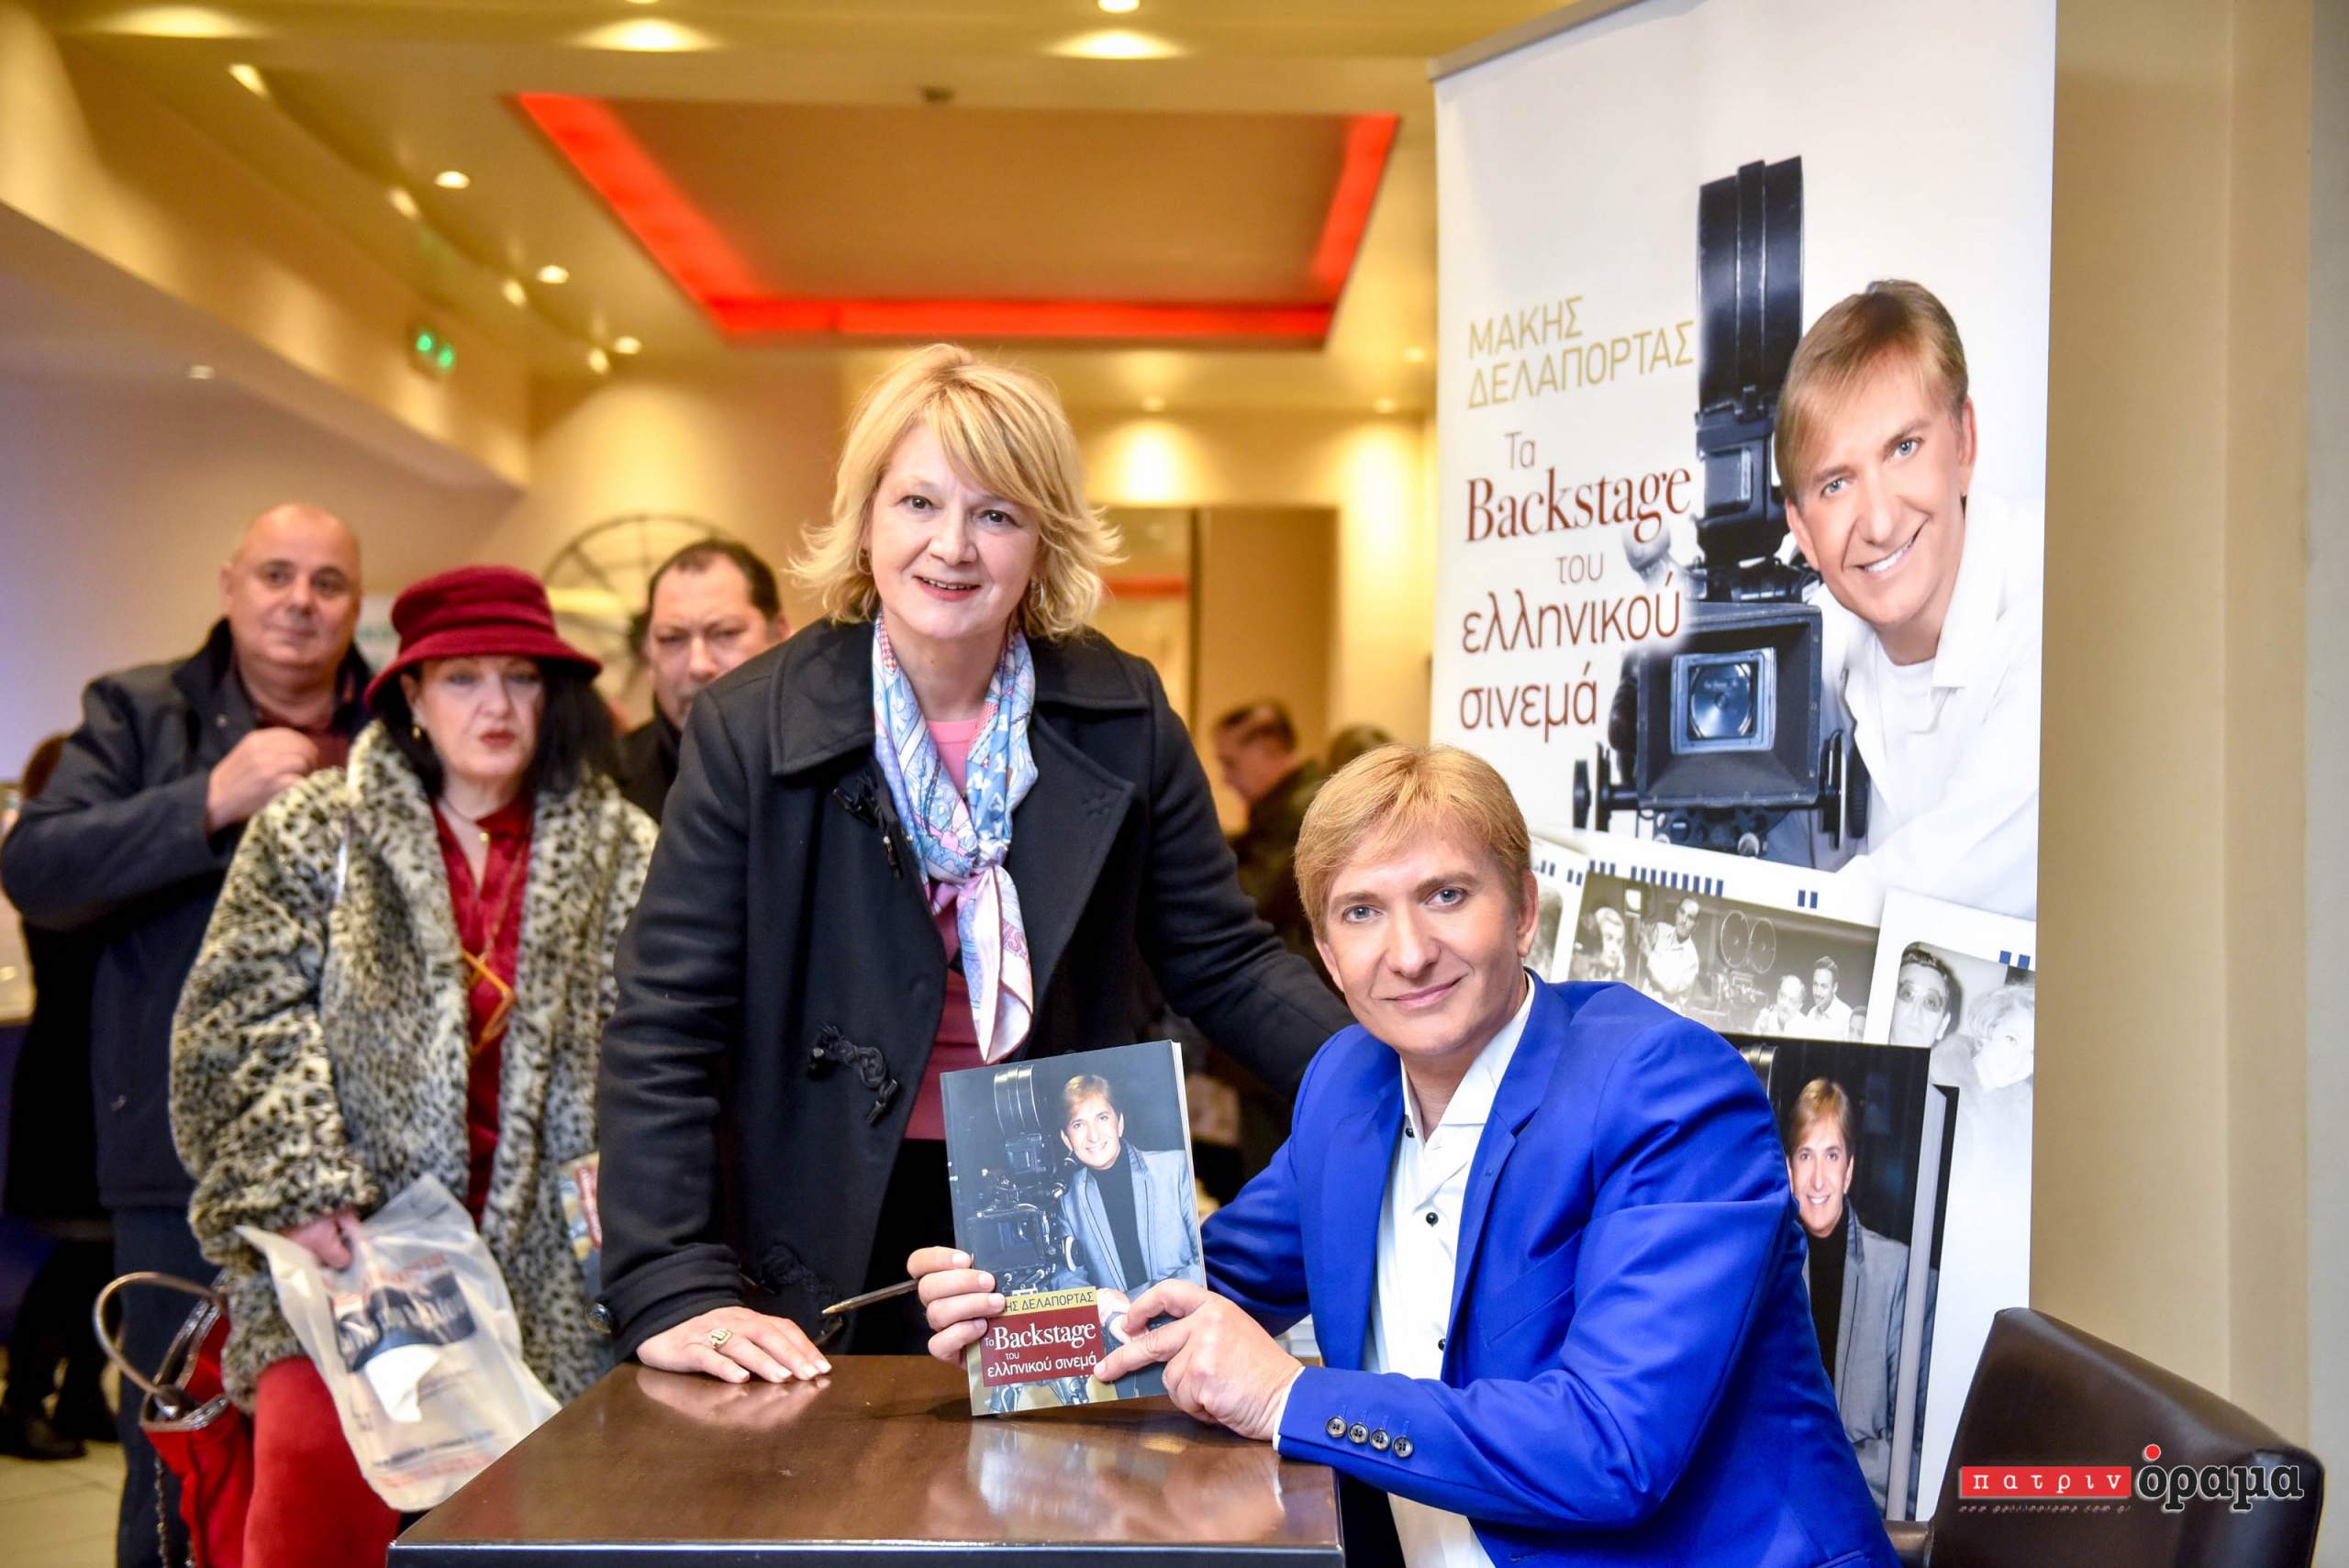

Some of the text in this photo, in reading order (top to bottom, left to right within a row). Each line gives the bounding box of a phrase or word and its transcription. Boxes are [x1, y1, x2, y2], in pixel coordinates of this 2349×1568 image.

[1468, 295, 1584, 360] ΜΑΚΗΣ
[1467, 319, 1695, 409] ΔΕΛΑΠΟΡΤΑΣ
[1504, 431, 1537, 470] Τα
[1464, 465, 1692, 544] Backstage
[1555, 551, 1605, 584] του
[1462, 570, 1680, 654] ελληνικού
[1459, 661, 1598, 744] σινεμά
[1021, 1291, 1095, 1310] ΔΕΛΑΠΟΡΤΑΣ
[993, 1322, 1097, 1351] Backstage
[1005, 1351, 1020, 1361] του
[987, 1351, 1097, 1377] ελληνικού σινεμά
